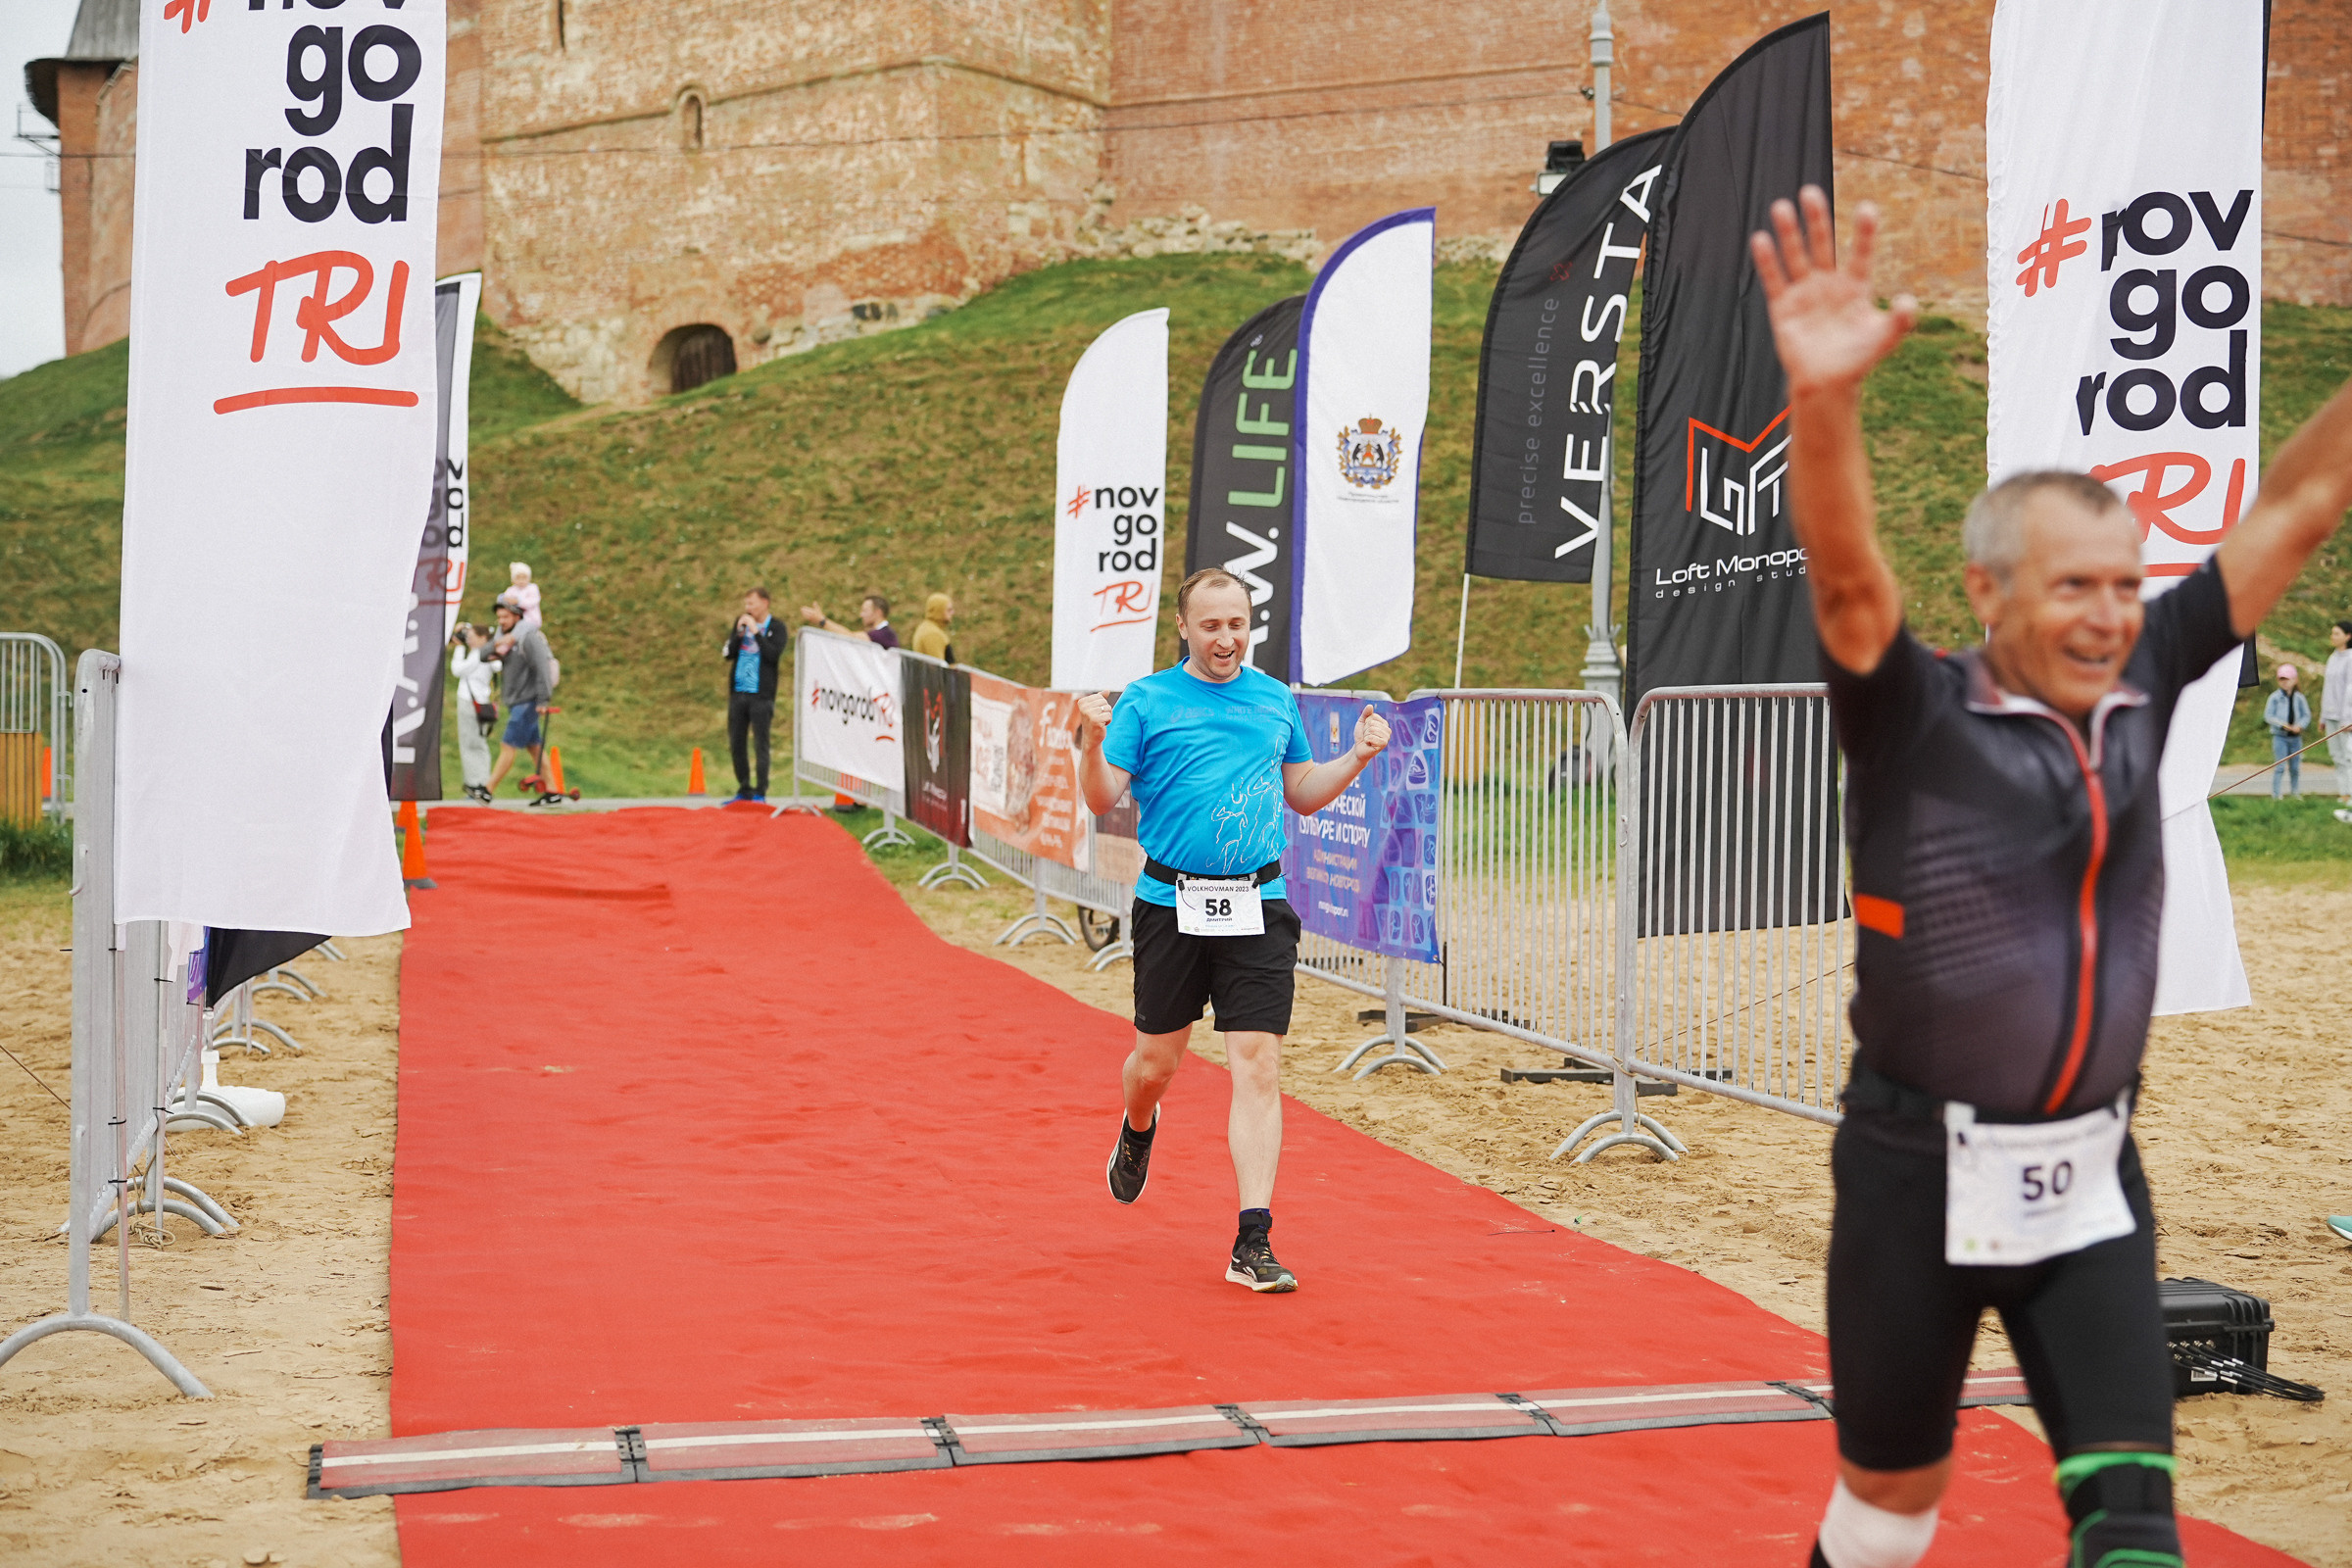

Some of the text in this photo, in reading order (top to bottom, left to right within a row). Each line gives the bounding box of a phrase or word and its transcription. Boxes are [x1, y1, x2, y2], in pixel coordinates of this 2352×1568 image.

[283, 24, 422, 137] go
[243, 103, 415, 224] rod
[224, 250, 410, 367] TRI
[2109, 265, 2250, 361] go
[1554, 164, 1663, 559] VERSTA
[2075, 329, 2248, 436] rod
[1518, 298, 1560, 525] precise excellence
[1067, 485, 1159, 519] #nov
[1113, 514, 1157, 546] go
[1099, 538, 1157, 572] rod
[1655, 548, 1810, 586] Loft Monopo
[1093, 580, 1153, 614] TRI
[1655, 565, 1806, 599] design stud
[1204, 898, 1233, 916] 58
[2022, 1160, 2074, 1201] 50
